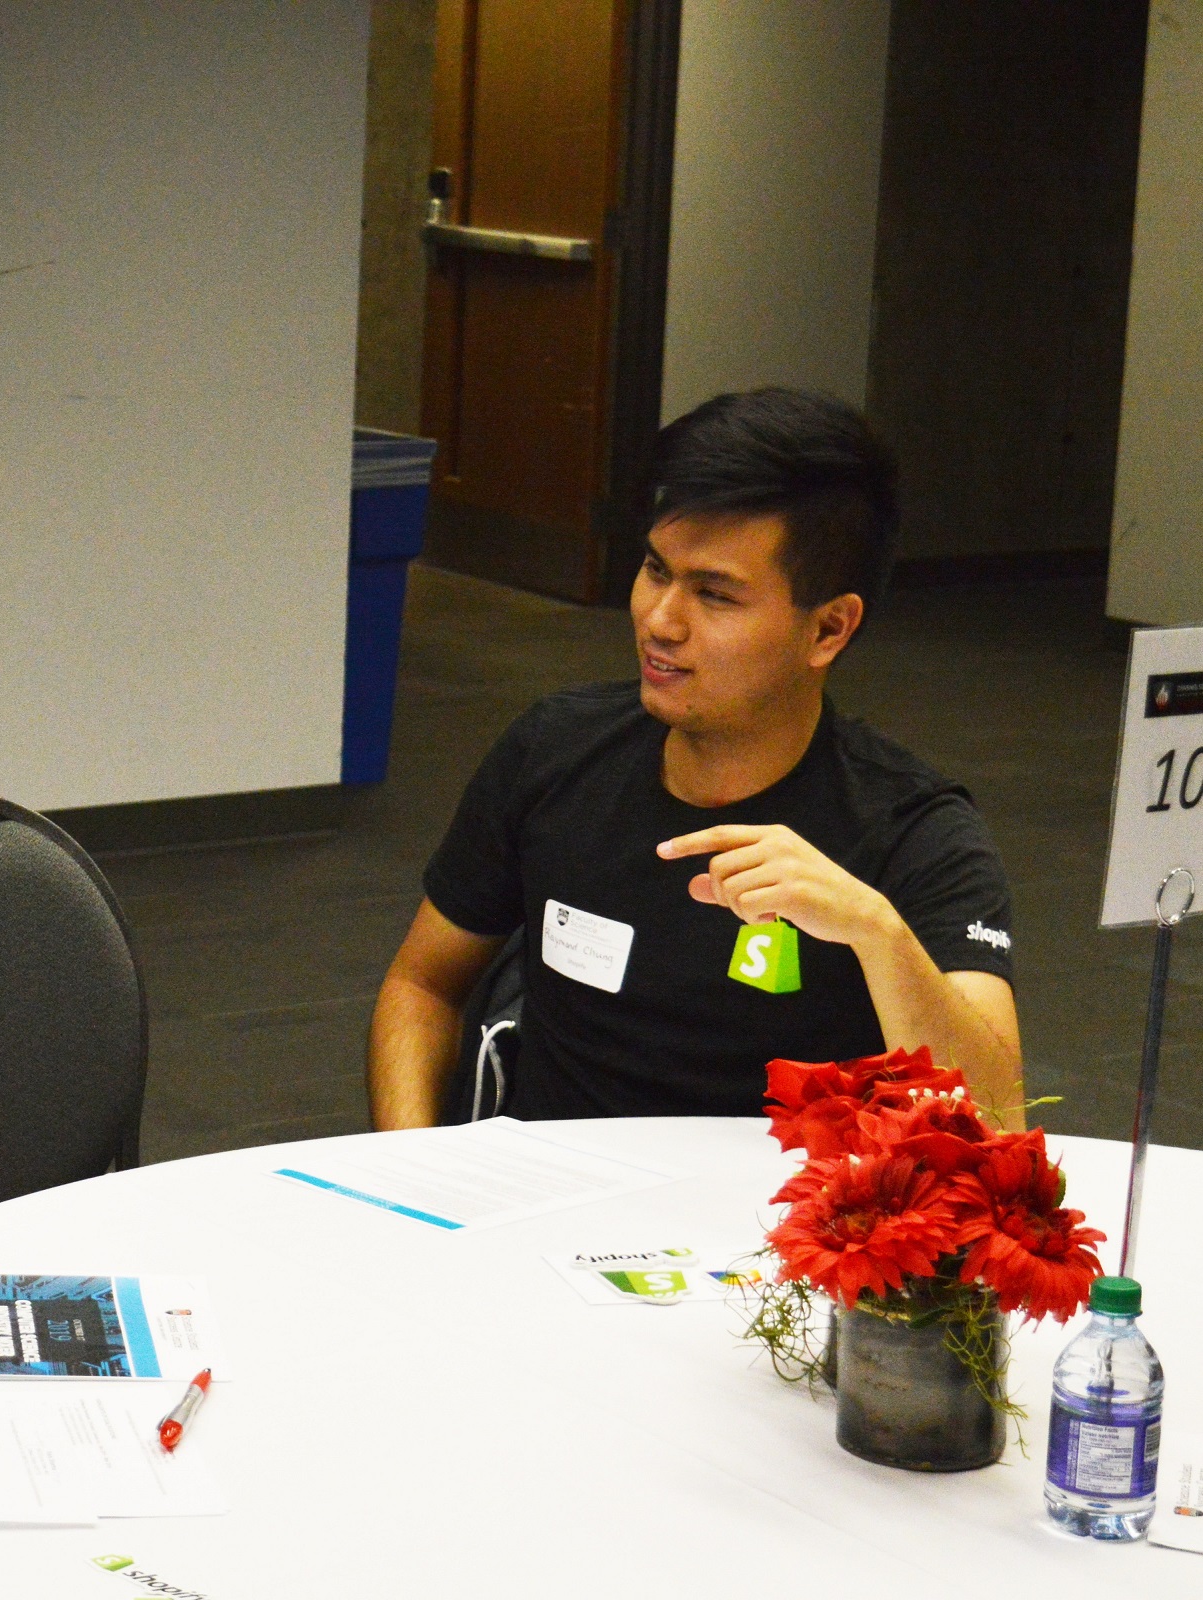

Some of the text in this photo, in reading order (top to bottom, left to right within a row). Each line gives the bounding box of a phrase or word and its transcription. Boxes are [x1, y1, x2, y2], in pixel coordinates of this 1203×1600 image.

[1146, 746, 1203, 812] 10
[739, 934, 772, 978] S
[575, 1253, 657, 1263] shopify
[47, 1319, 72, 1342] 2019
[20, 1334, 41, 1363] SCIENCE
[123, 1570, 208, 1600] shopif
